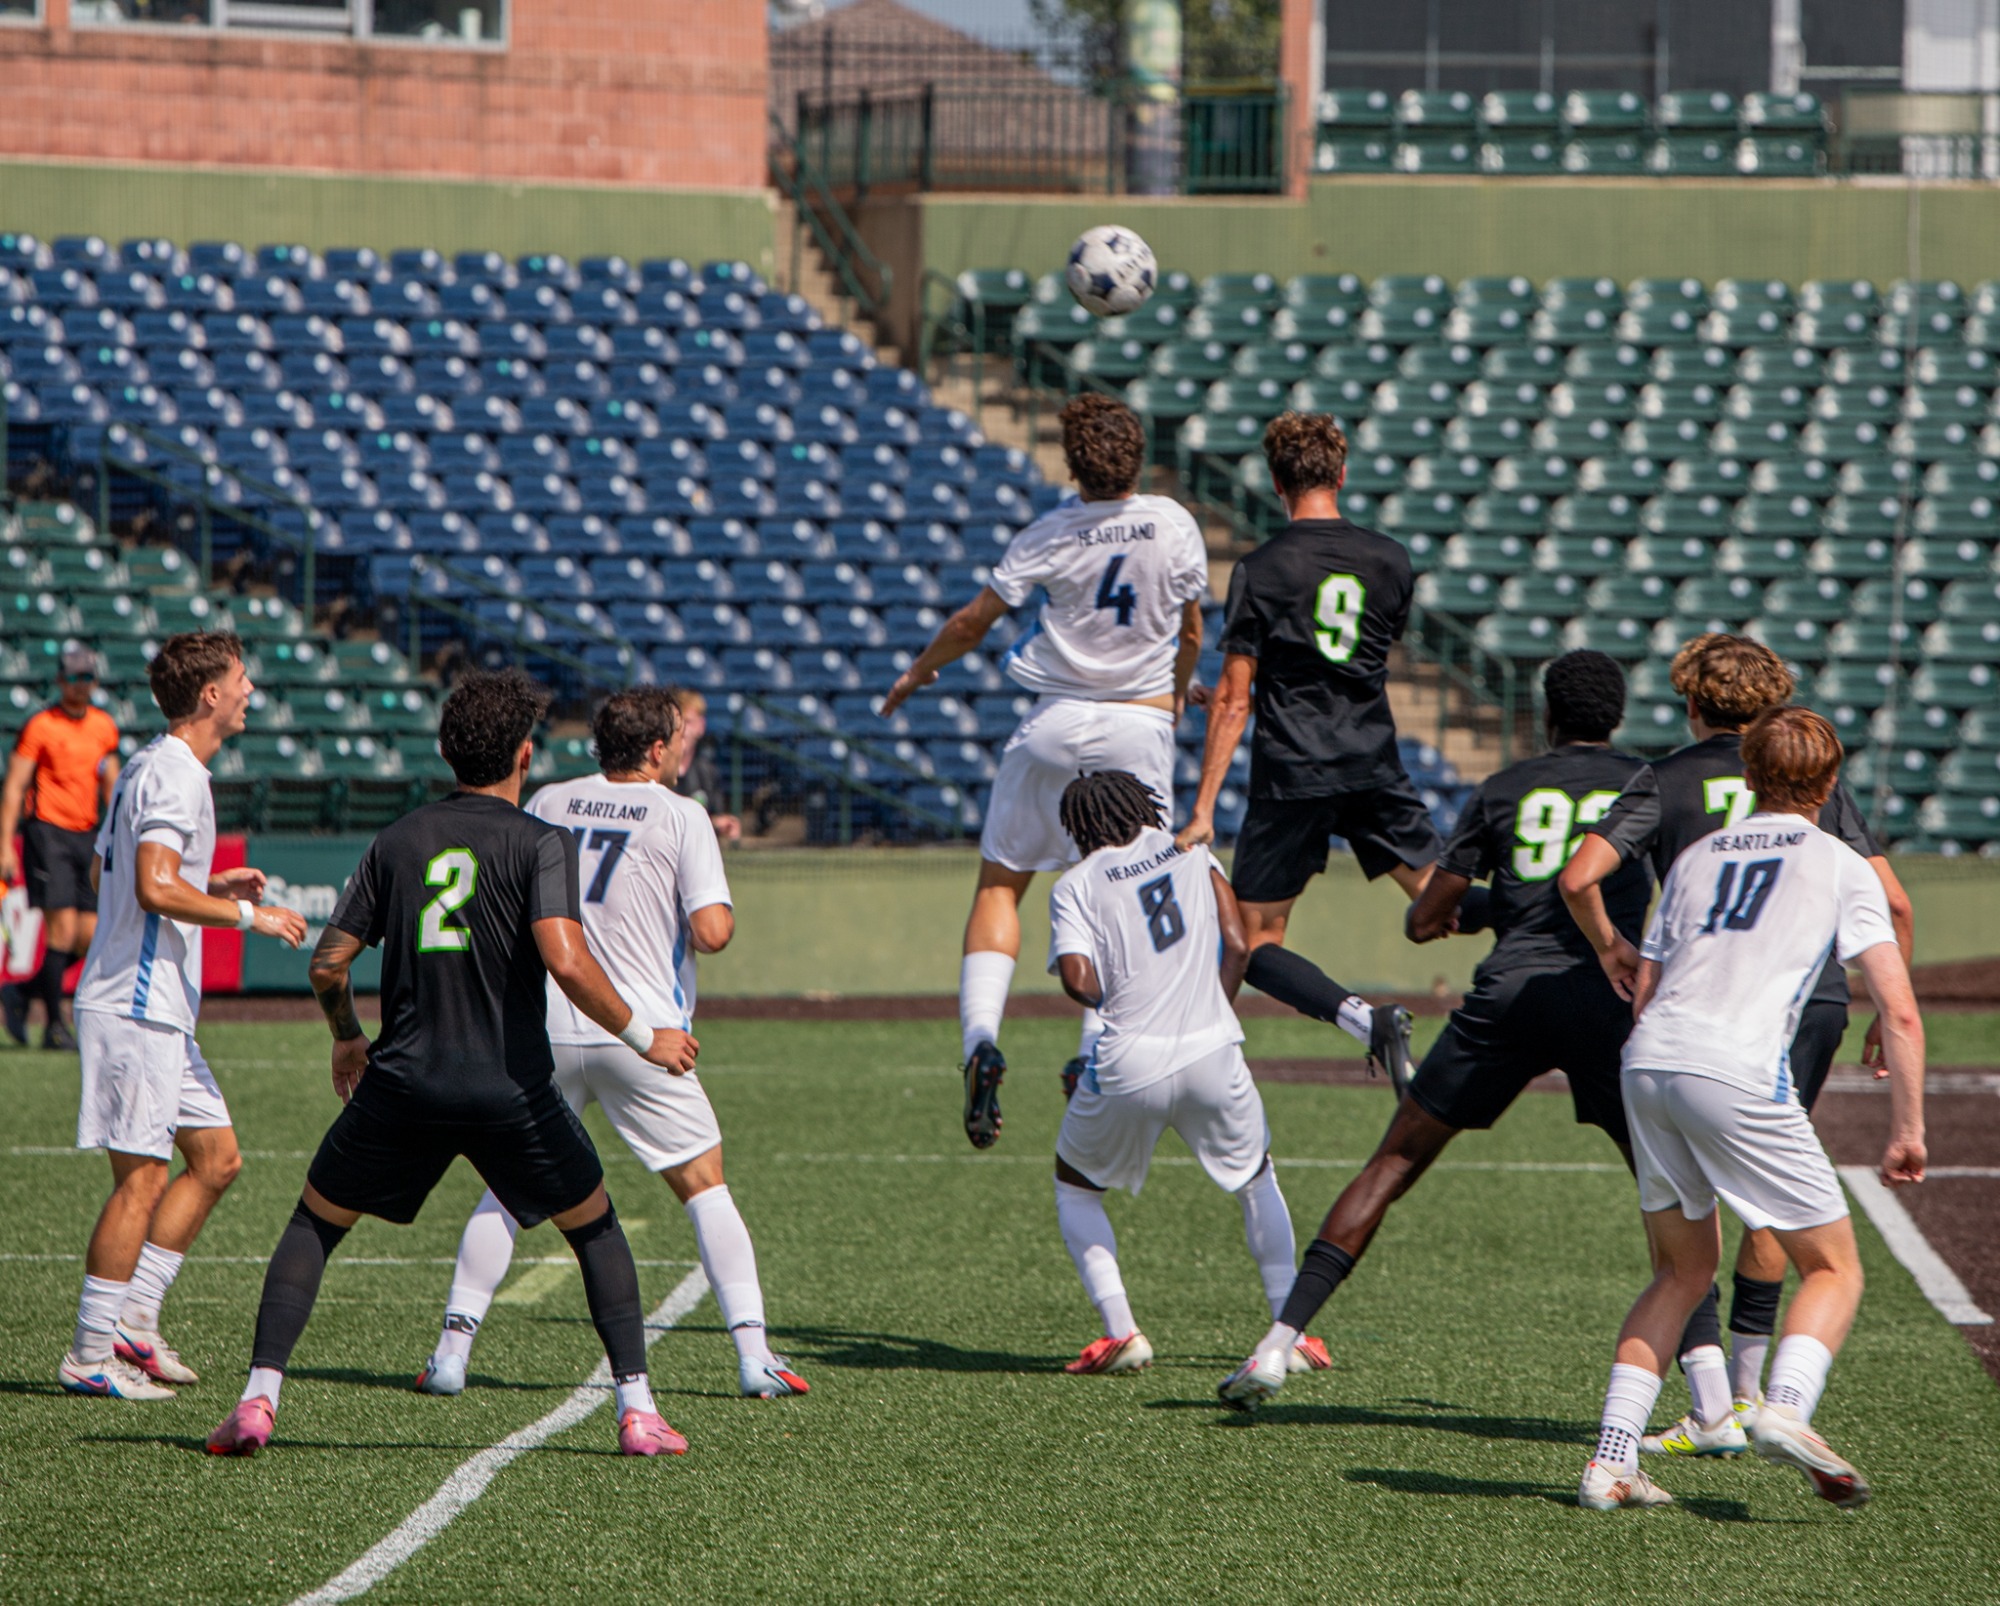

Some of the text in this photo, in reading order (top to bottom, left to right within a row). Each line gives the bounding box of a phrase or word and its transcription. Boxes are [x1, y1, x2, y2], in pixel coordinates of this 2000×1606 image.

[1078, 523, 1156, 548] HEARTLAND
[1094, 553, 1138, 627] 4
[1313, 573, 1367, 664] 9
[566, 797, 649, 822] HEARTLAND
[1703, 775, 1757, 829] 7
[1711, 831, 1808, 853] HEARTLAND
[418, 847, 479, 953] 2
[1137, 871, 1187, 955] 8
[1699, 856, 1784, 934] 10
